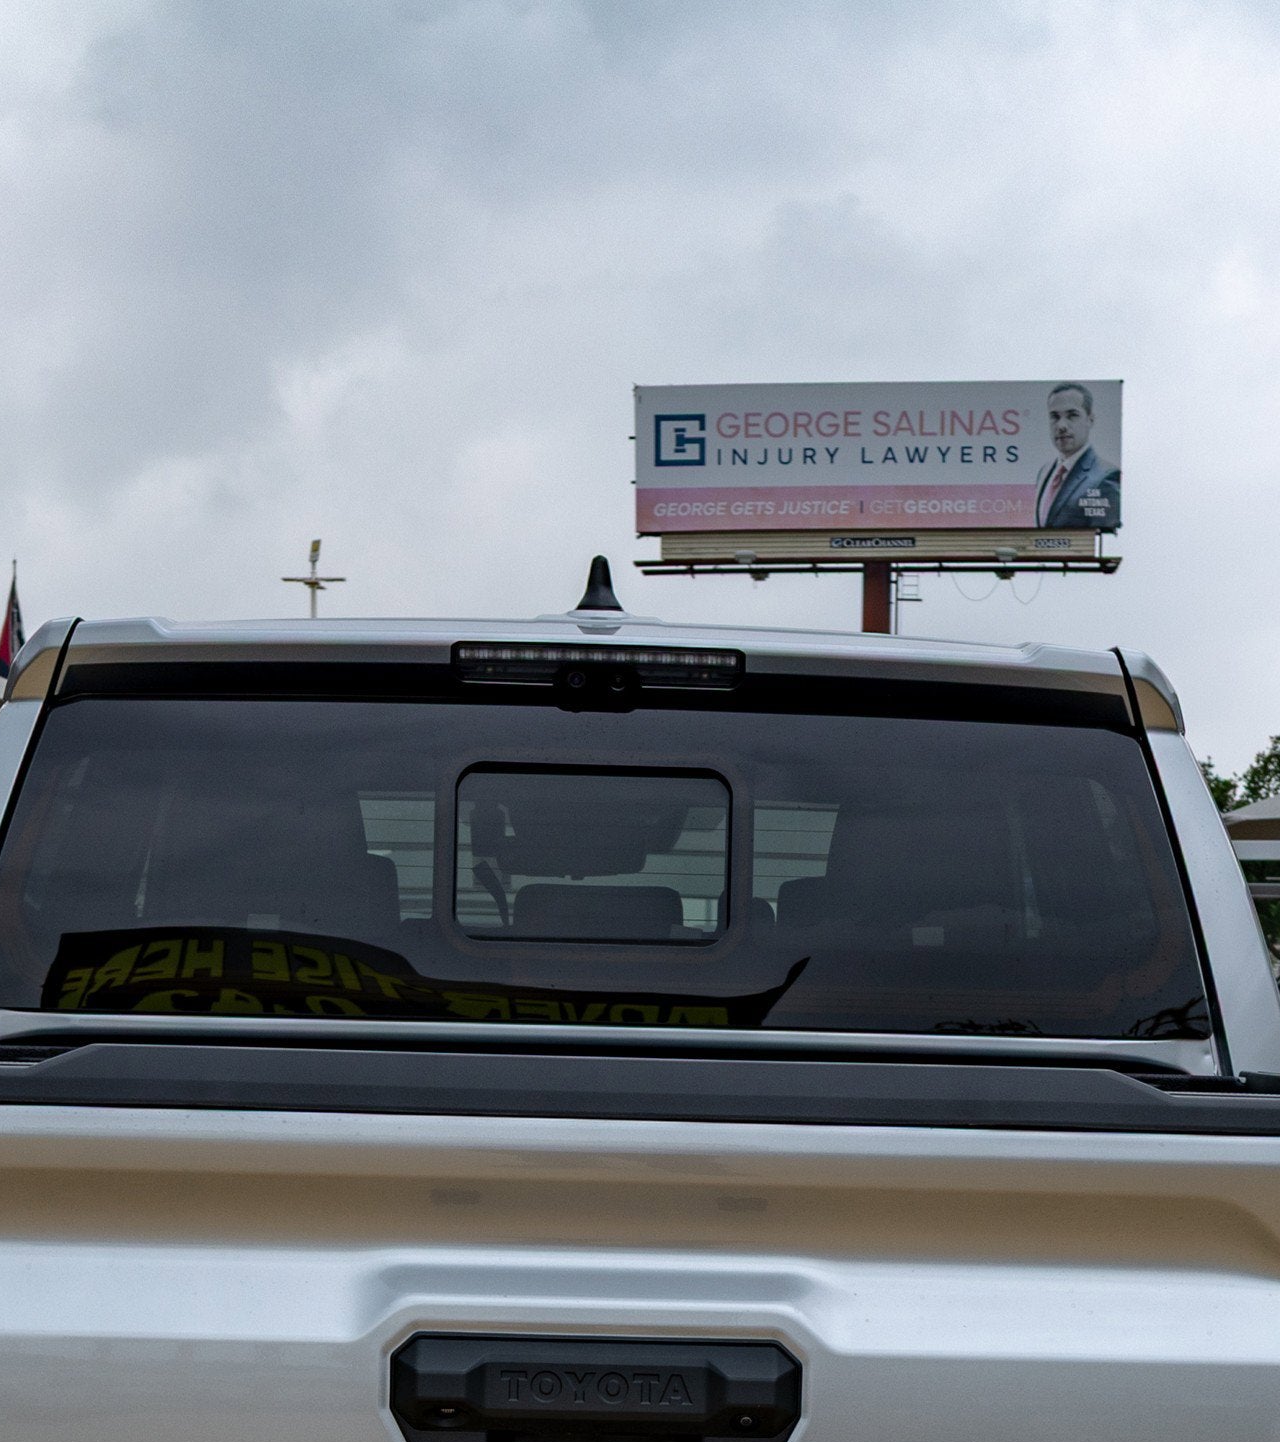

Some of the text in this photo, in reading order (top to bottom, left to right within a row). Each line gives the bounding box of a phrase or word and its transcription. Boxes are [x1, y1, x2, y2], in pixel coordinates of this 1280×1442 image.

[716, 409, 1020, 438] GEORGE SALINAS
[716, 445, 1020, 466] INJURY LAWYERS
[1087, 488, 1100, 497] SAN
[653, 502, 726, 517] GEORGE
[730, 501, 775, 516] GETS
[1084, 508, 1106, 517] TEXAS
[500, 1370, 694, 1407] TOYOTA
